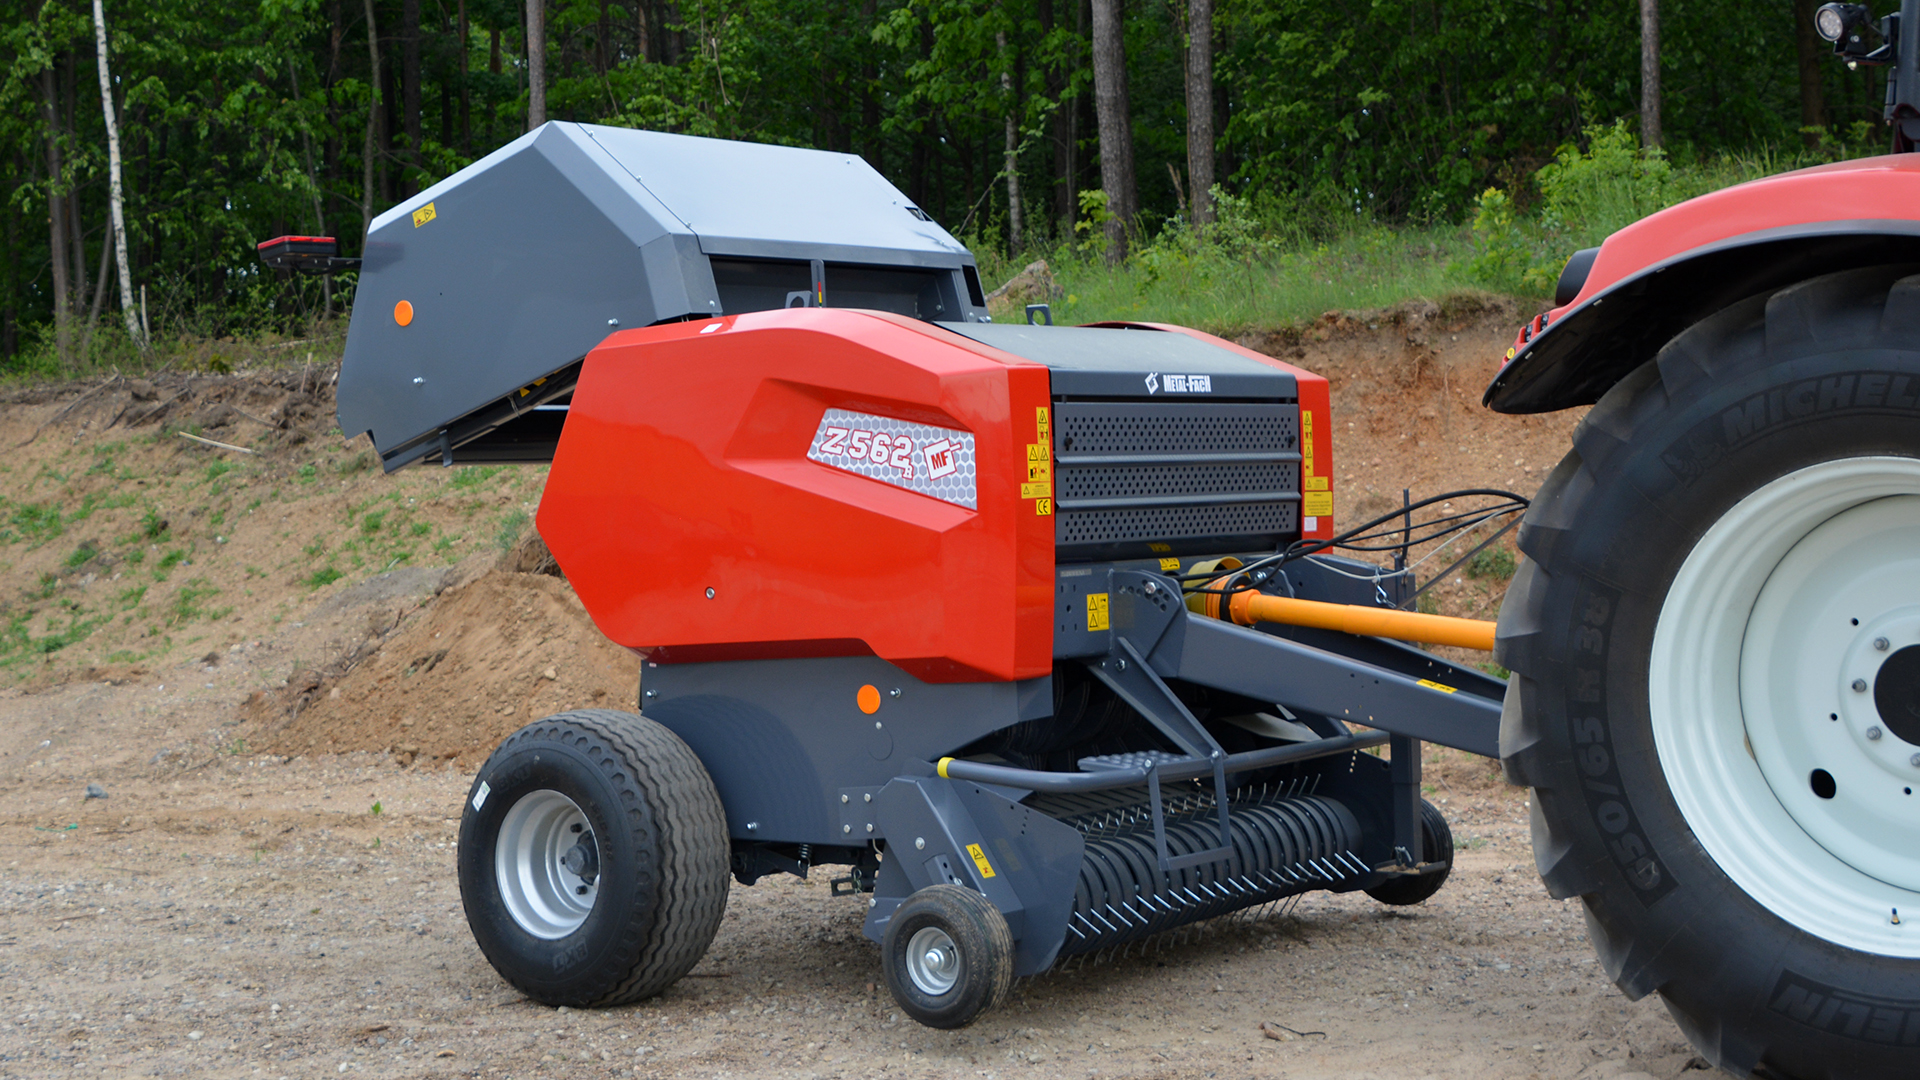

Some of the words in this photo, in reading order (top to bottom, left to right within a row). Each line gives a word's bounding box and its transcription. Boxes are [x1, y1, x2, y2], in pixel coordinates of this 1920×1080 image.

[1722, 373, 1920, 446] MICHEL
[930, 451, 949, 471] MF
[1573, 592, 1611, 655] 38
[1572, 667, 1601, 703] R
[1573, 716, 1662, 892] 650/65
